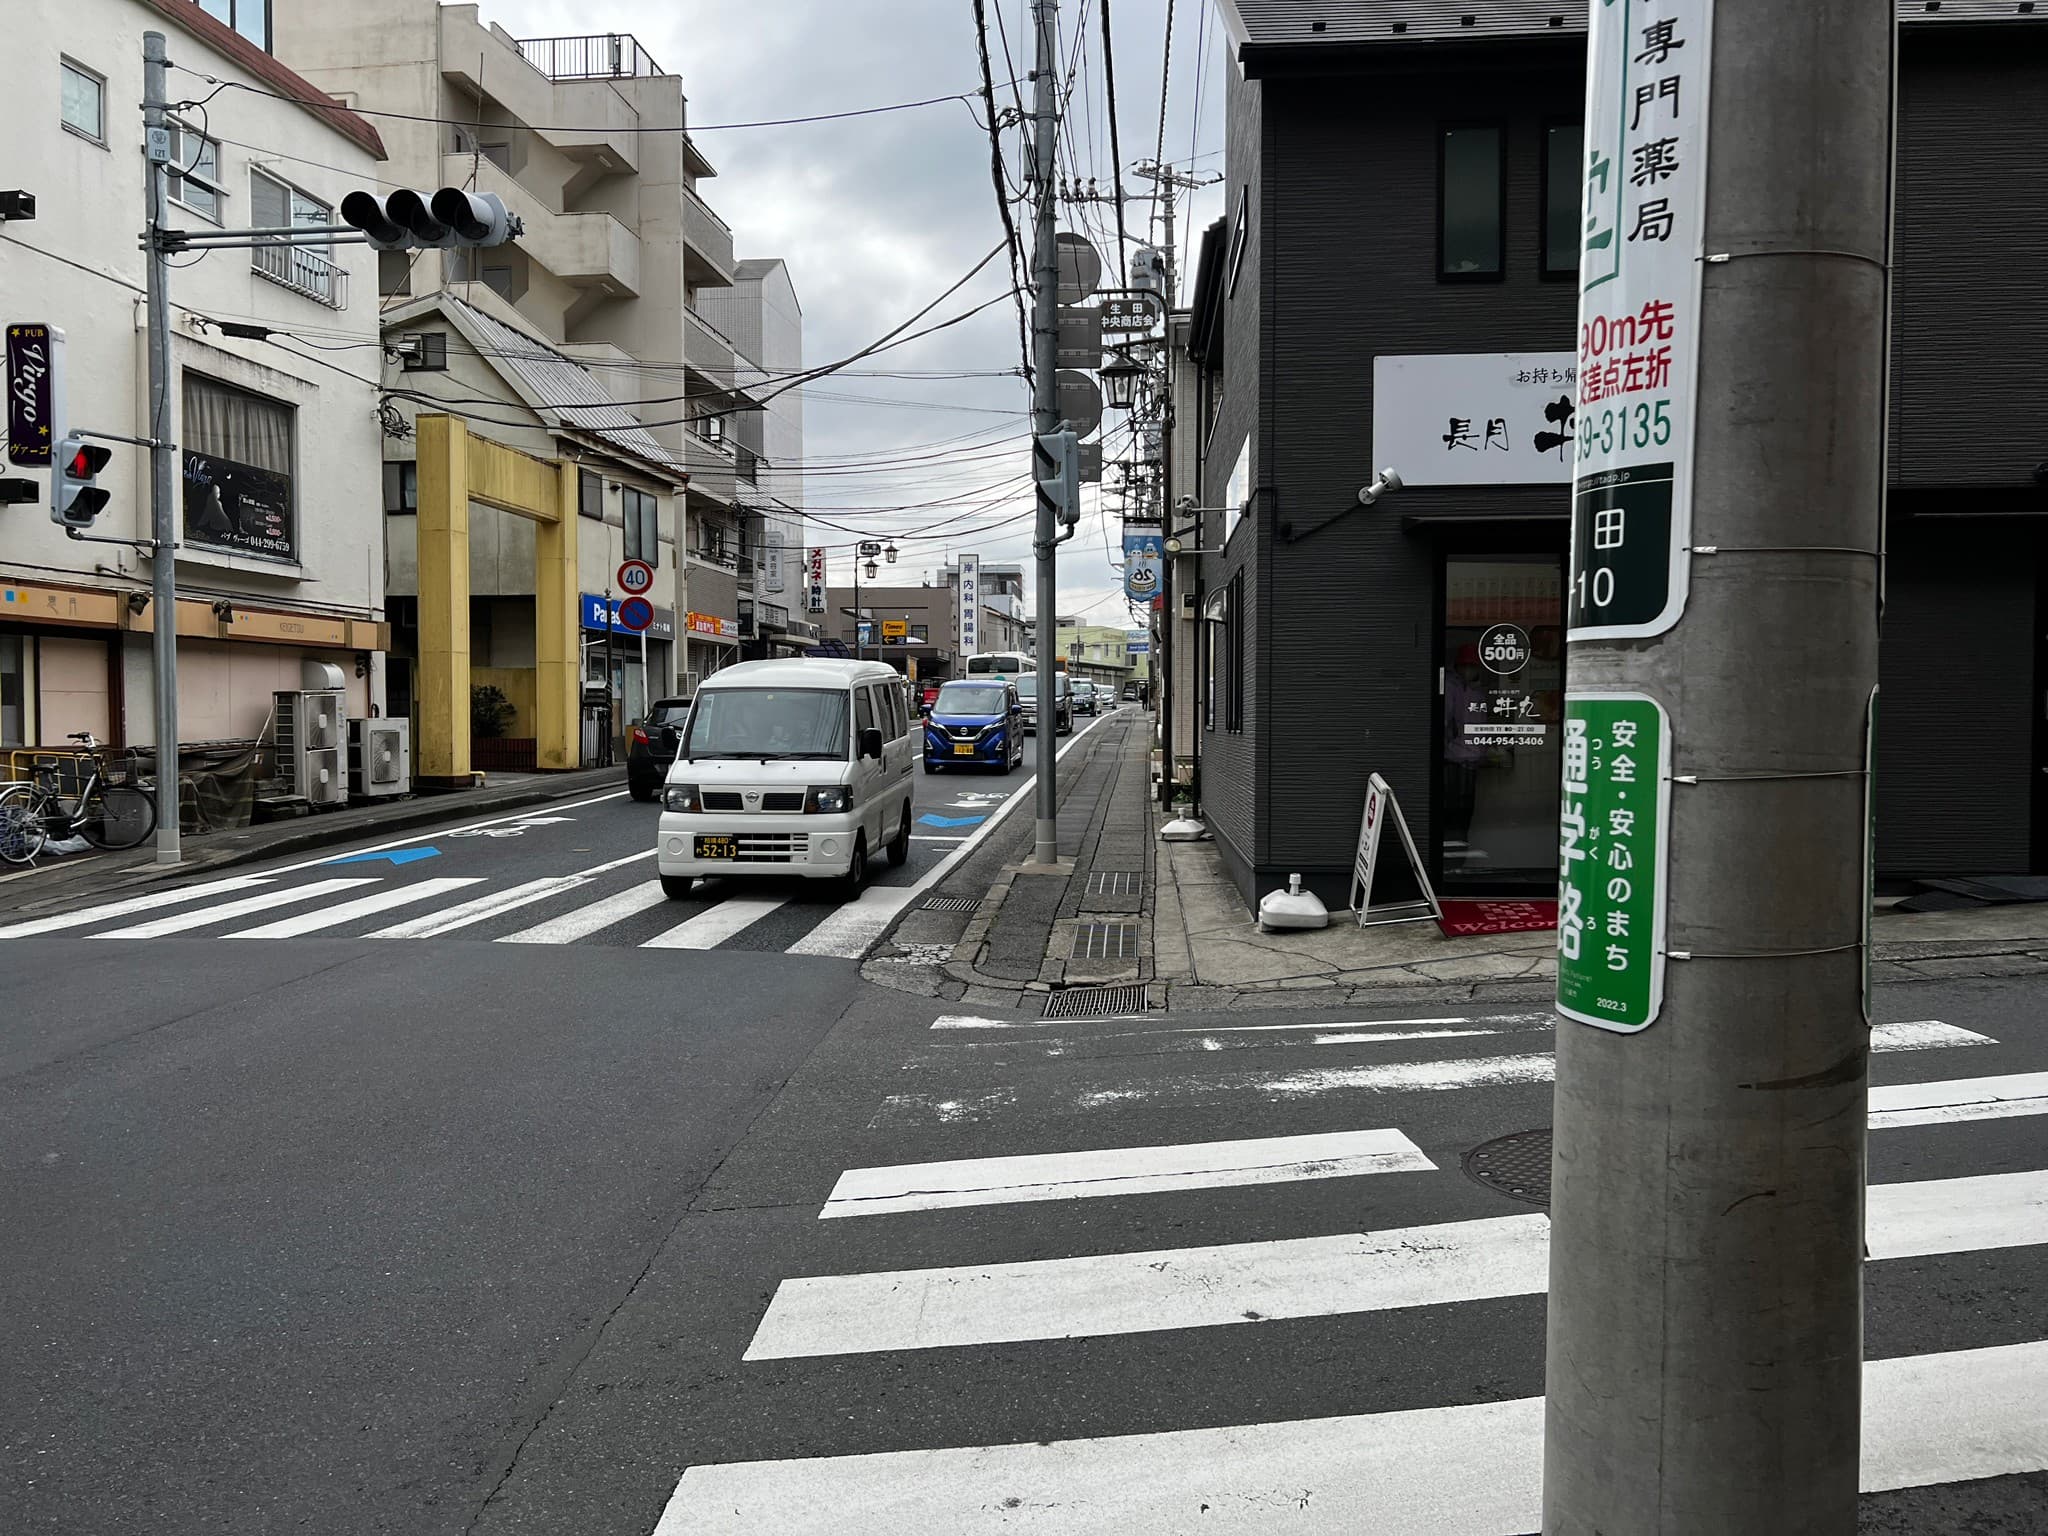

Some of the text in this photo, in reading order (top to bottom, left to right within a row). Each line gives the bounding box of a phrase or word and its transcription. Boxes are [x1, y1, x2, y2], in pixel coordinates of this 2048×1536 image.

[1627, 17, 1685, 243] 専門薬局
[1101, 314, 1154, 328] 中央商店会
[24, 328, 44, 337] PUB
[14, 343, 46, 424] Virgo
[10, 444, 50, 455] ヴァーゴ
[626, 569, 645, 585] 40
[1493, 633, 1517, 645] 全品
[1484, 646, 1524, 660] 500円
[1473, 736, 1544, 745] 044-954-3406
[703, 844, 737, 857] 52-13
[1606, 719, 1638, 972] 安全・安心のまち
[1596, 997, 1627, 1012] 2022.3
